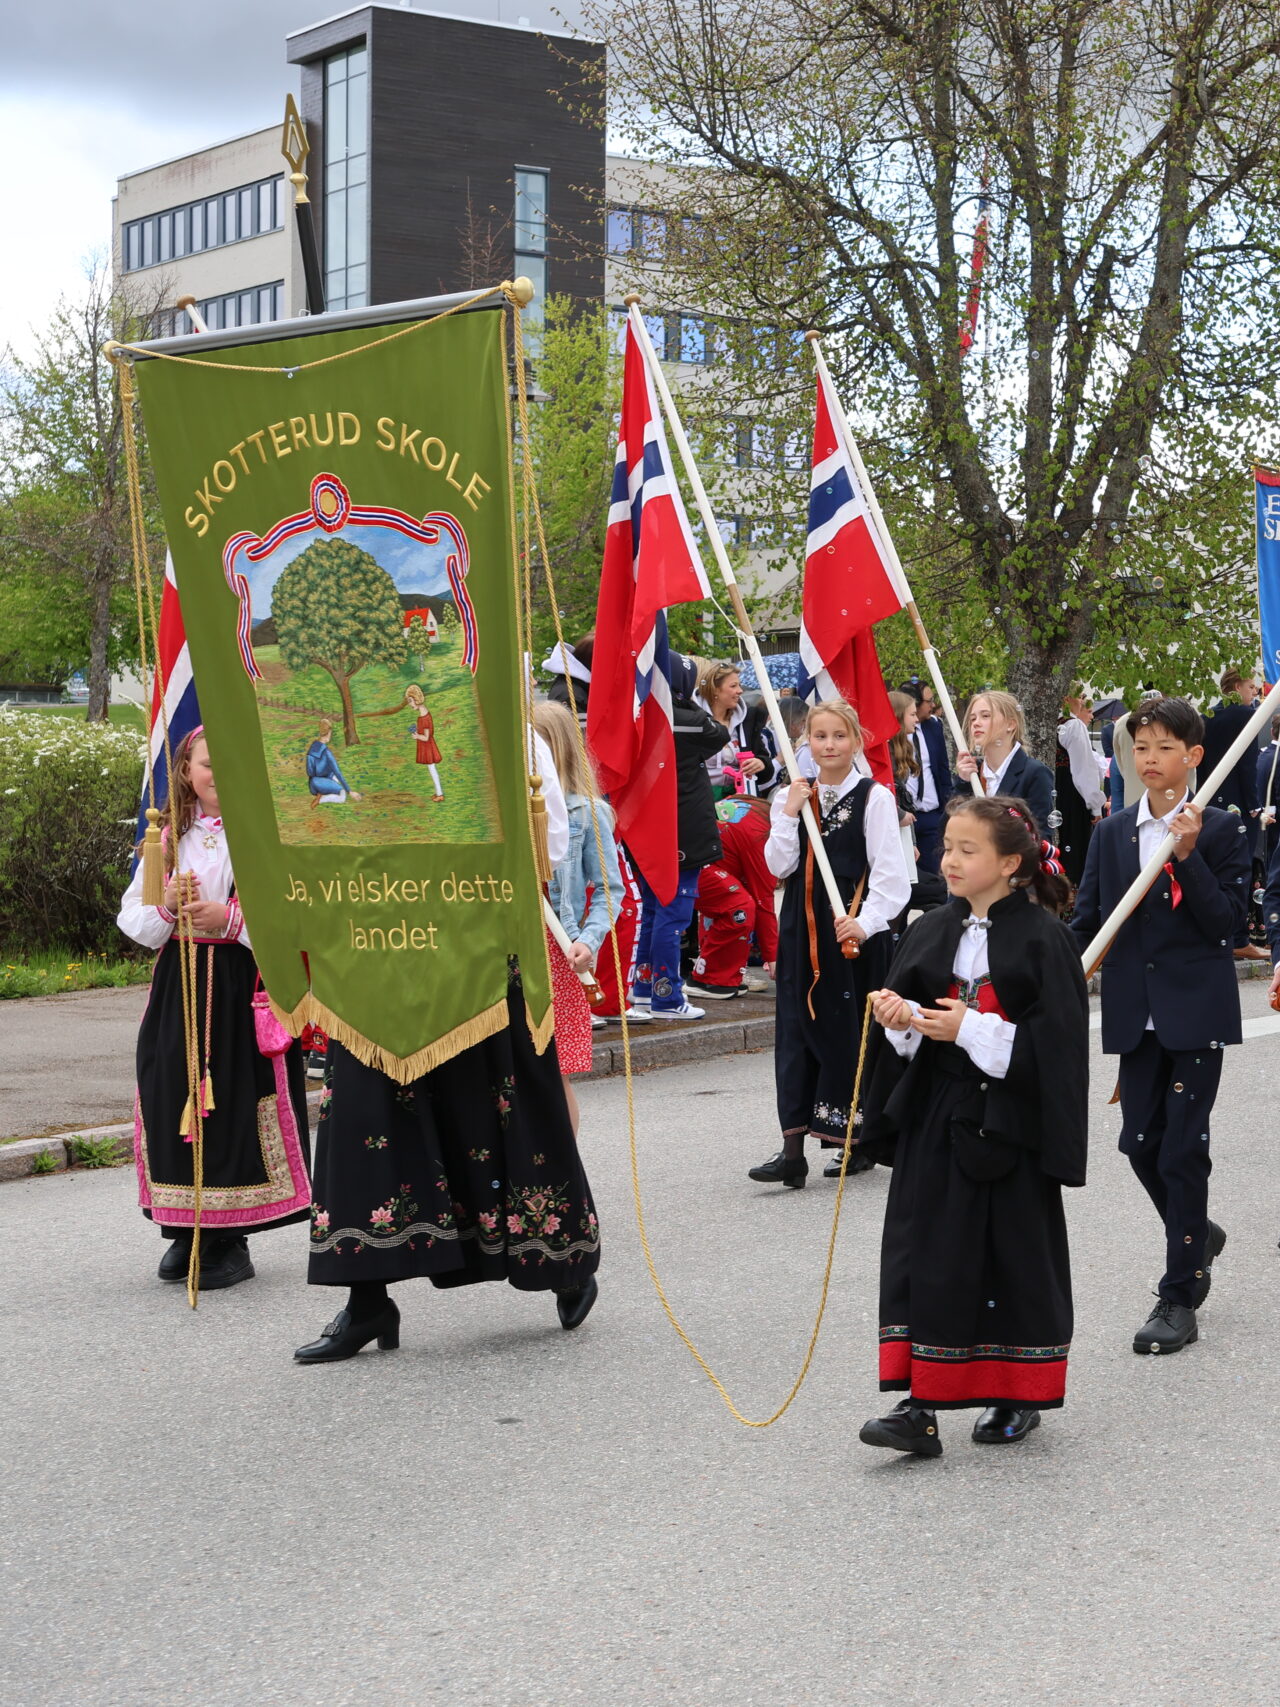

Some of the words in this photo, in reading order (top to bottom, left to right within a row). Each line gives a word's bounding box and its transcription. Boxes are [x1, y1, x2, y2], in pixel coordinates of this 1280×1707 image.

[184, 411, 361, 538] SKOTTERUD
[376, 416, 492, 512] SKOLE
[284, 873, 313, 907] Ja,
[319, 872, 342, 902] vi
[348, 872, 430, 902] elsker
[440, 872, 514, 902] dette
[349, 919, 438, 950] landet
